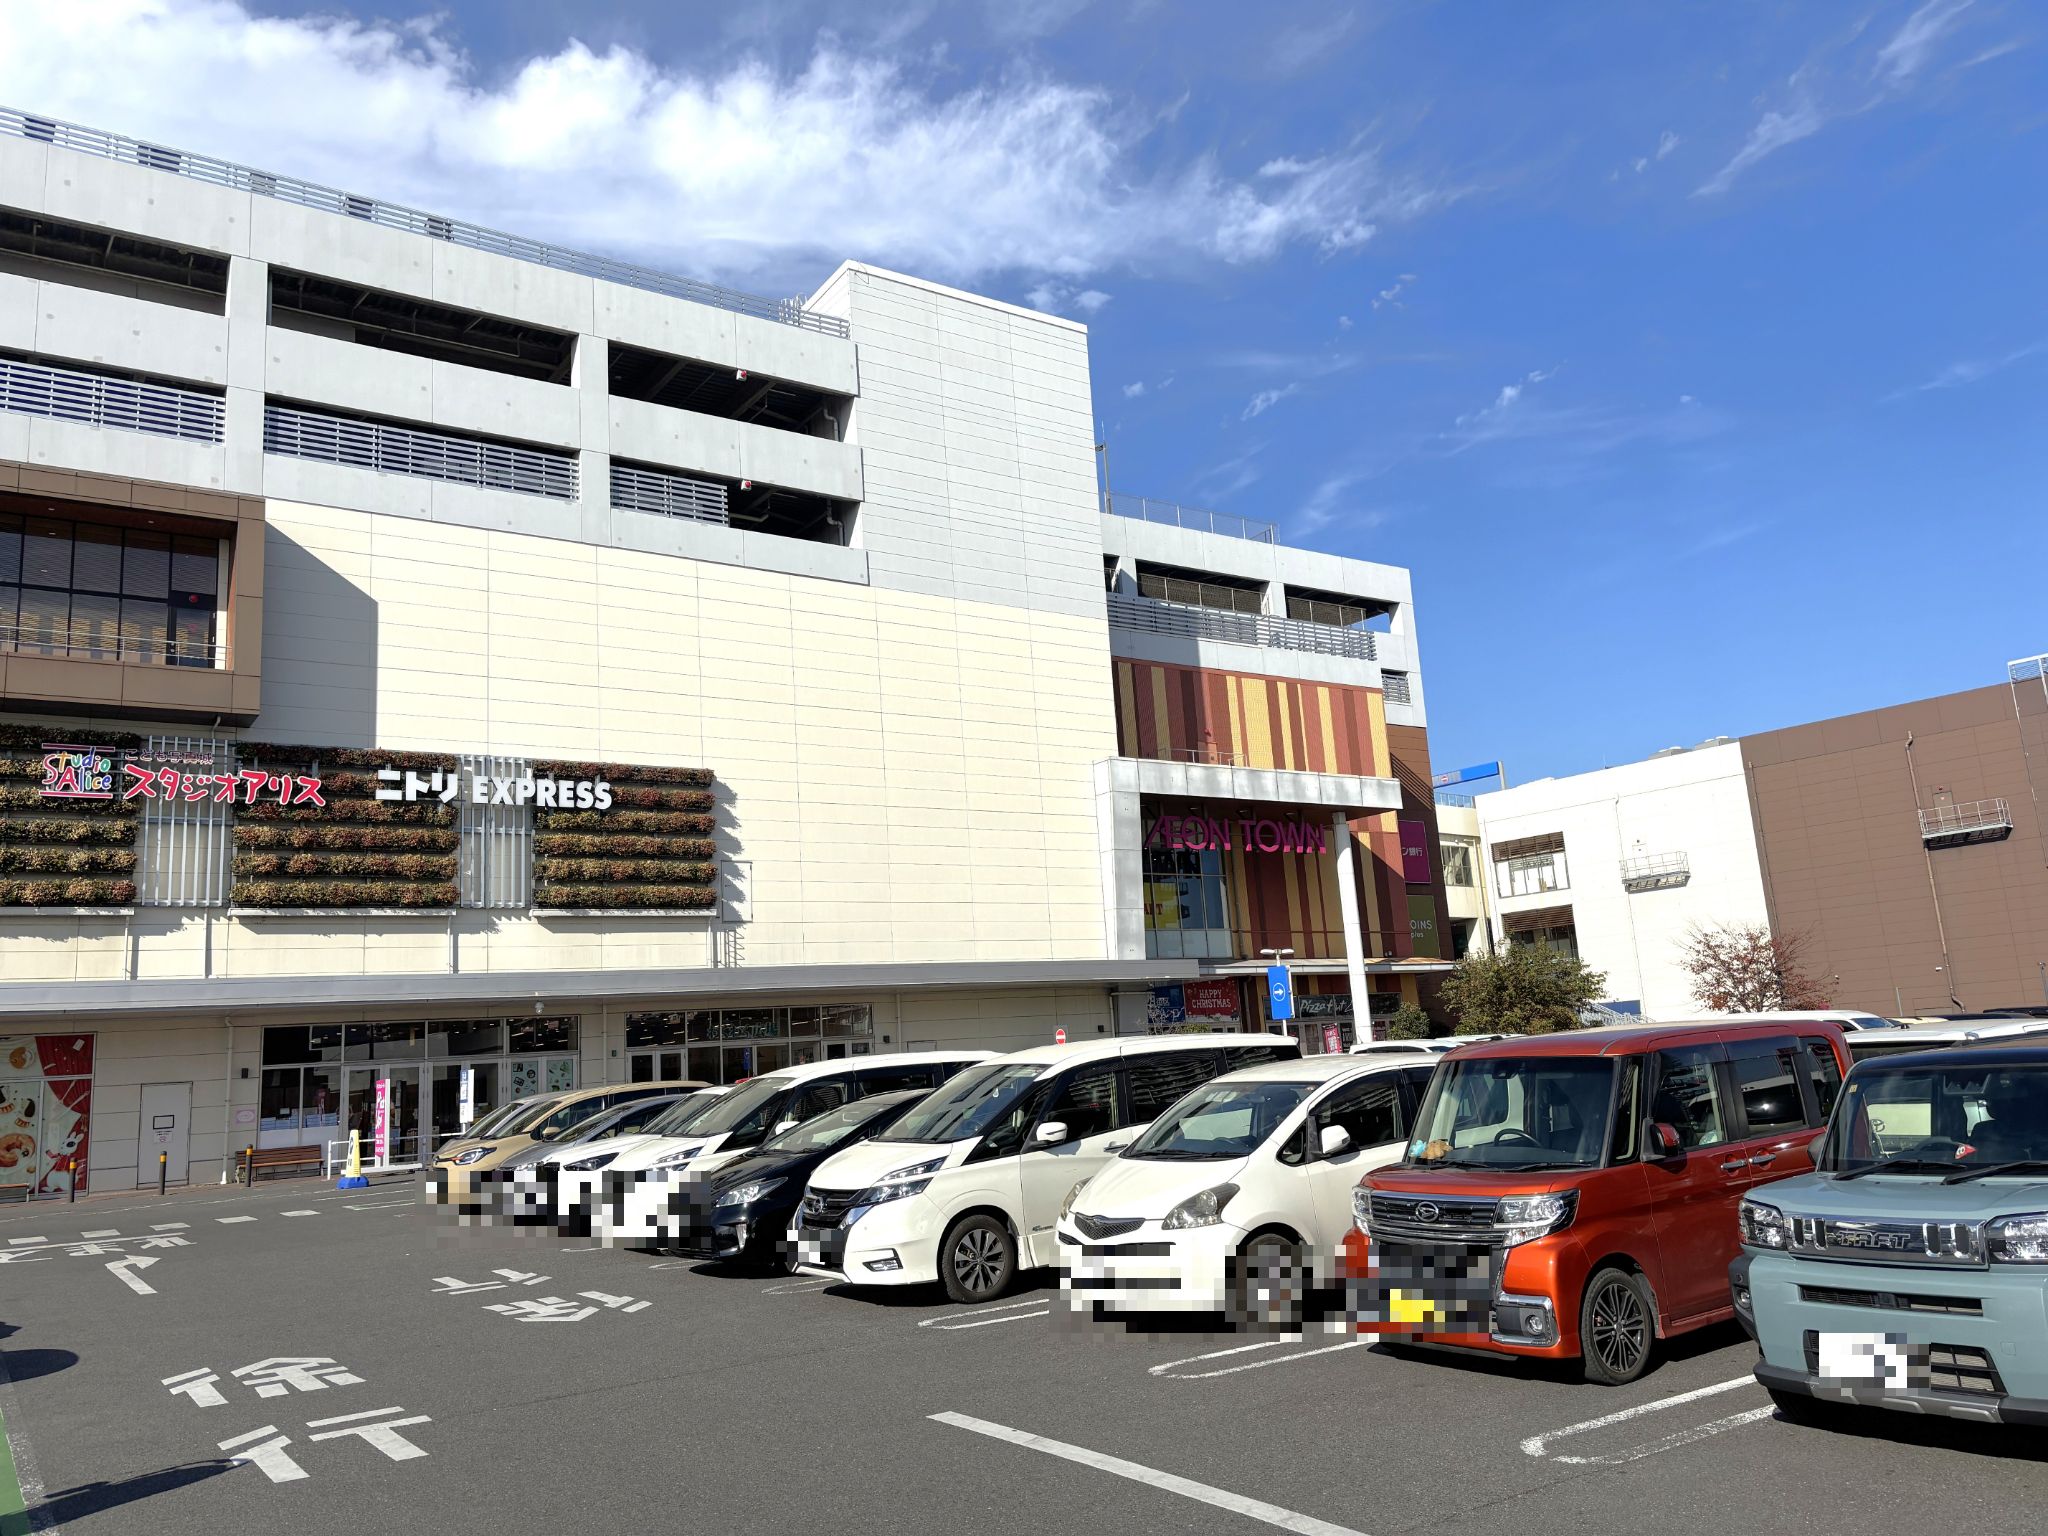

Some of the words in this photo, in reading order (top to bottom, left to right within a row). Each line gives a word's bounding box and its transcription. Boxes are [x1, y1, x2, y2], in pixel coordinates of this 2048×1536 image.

[42, 746, 112, 784] Studio
[56, 766, 113, 793] Alice
[122, 763, 327, 807] スタジオアリス
[375, 769, 459, 804] ニトリ
[471, 774, 613, 810] EXPRESS
[1237, 819, 1328, 854] TOWN
[1191, 998, 1232, 1008] CHRISTMAS
[1199, 988, 1223, 999] HAPPY
[1300, 999, 1326, 1013] Pizza
[1327, 998, 1346, 1013] Hut
[1837, 1230, 1911, 1249] TAFT
